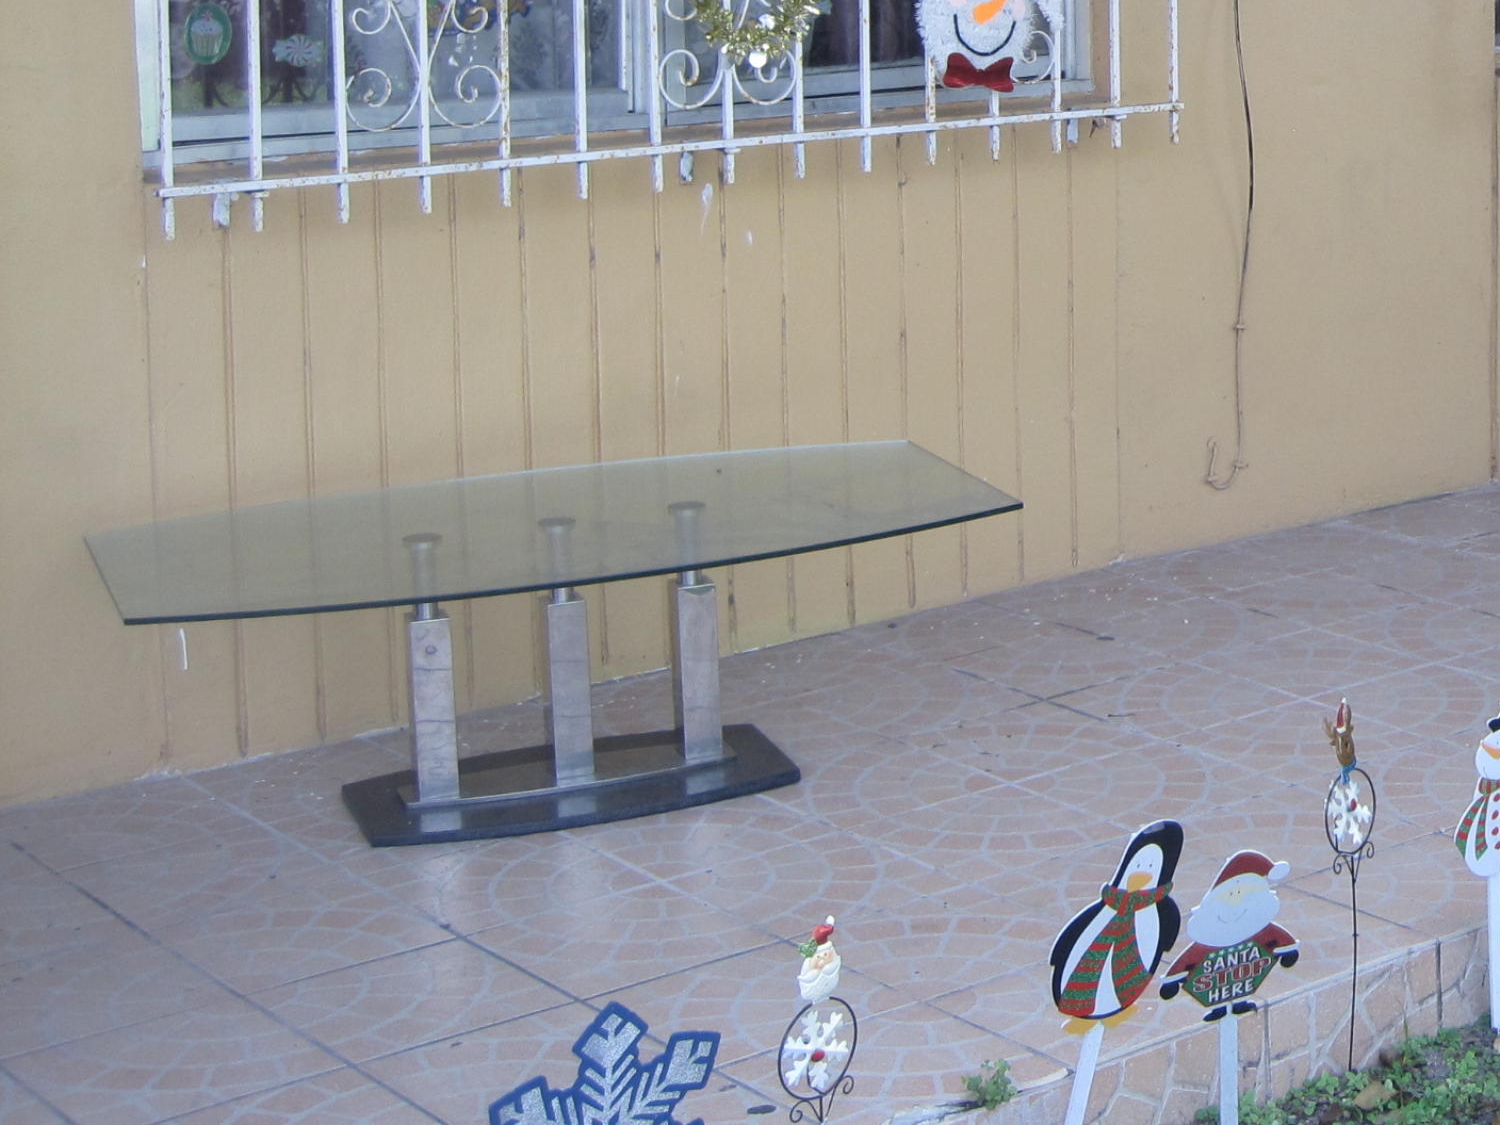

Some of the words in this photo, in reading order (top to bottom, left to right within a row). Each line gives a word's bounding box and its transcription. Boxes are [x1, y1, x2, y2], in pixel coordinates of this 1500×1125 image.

[1203, 946, 1261, 974] SANTA
[1192, 957, 1271, 993] STOP
[1208, 978, 1254, 1003] HERE
